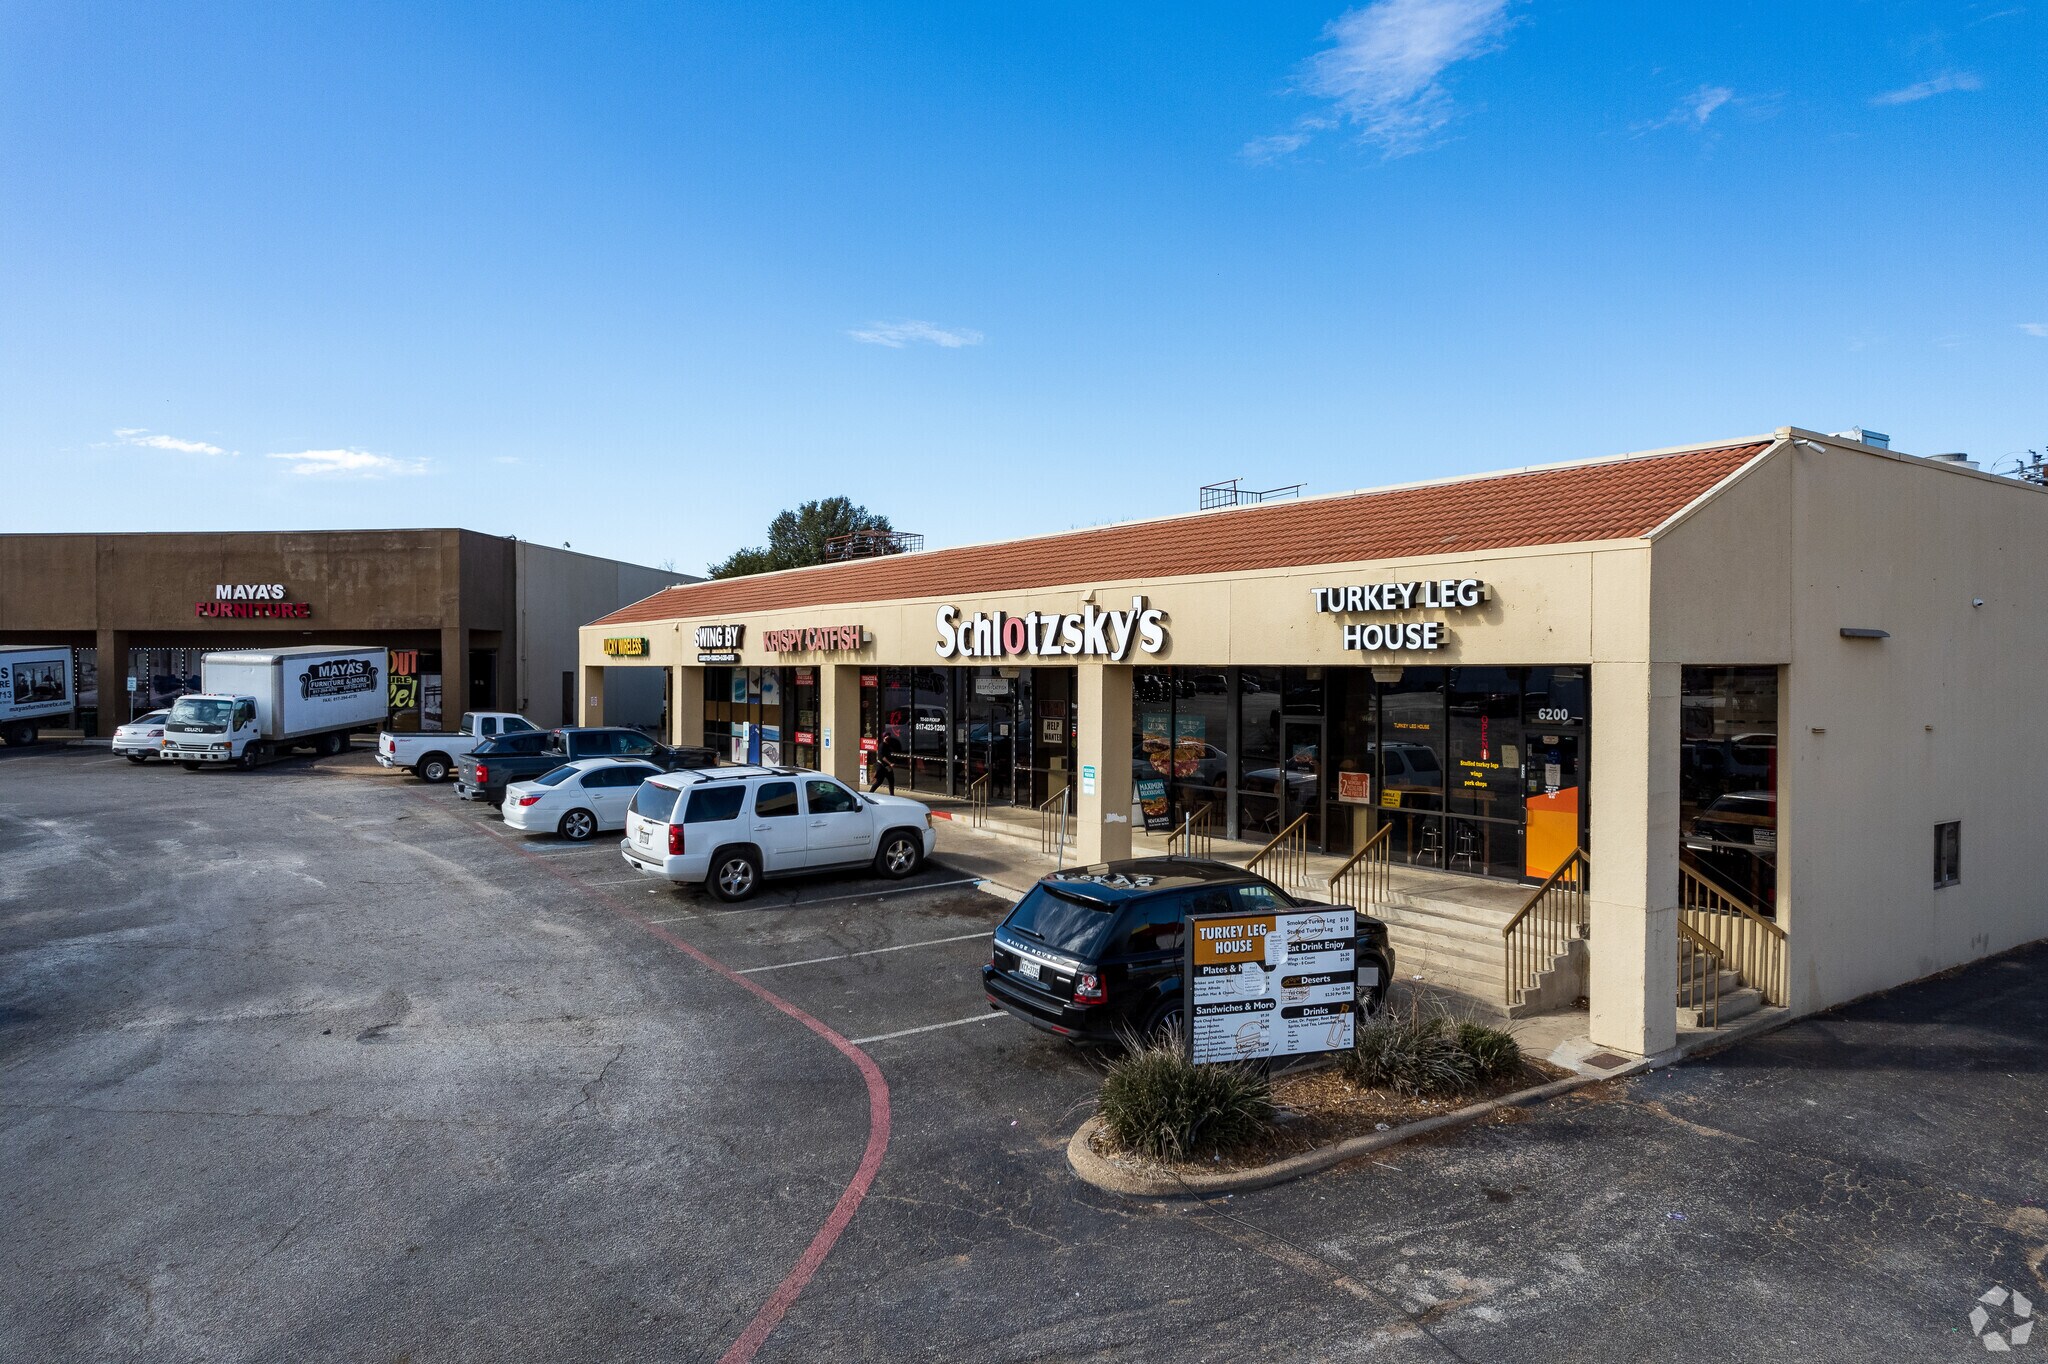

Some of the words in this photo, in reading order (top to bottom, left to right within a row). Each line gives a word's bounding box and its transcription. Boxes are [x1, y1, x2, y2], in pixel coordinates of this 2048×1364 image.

[215, 584, 284, 600] MAYA'S
[1310, 582, 1419, 613] TURKEY
[1425, 578, 1479, 608] LEG
[194, 602, 310, 618] FURNITURE
[935, 595, 1166, 662] Schlotzsky's
[694, 625, 723, 648] SWING
[725, 626, 739, 648] BY
[762, 628, 804, 653] KRISPY
[805, 624, 860, 651] CATFISH
[1342, 621, 1439, 651] HOUSE
[617, 637, 642, 655] WIRELESS
[318, 662, 363, 678] MAYA'S
[310, 677, 345, 688] FURNITURE
[345, 676, 351, 684] &
[351, 675, 367, 684] MORE
[1538, 708, 1568, 720] 6200
[915, 723, 945, 732] 817-423-1200
[1046, 721, 1059, 731] HELP
[1481, 715, 1489, 749] OPEN
[1044, 732, 1062, 742] WANTED
[1476, 761, 1491, 769] turkey
[1139, 781, 1164, 791] MAXIMUM
[1342, 779, 1348, 796] 2
[1199, 925, 1244, 940] TURKEY
[1247, 923, 1267, 937] LEG
[1006, 938, 1029, 951] RANGE
[1215, 939, 1253, 954] HOUSE
[1287, 944, 1300, 952] Eat
[1301, 942, 1323, 951] Drink
[1324, 941, 1345, 951] Enjoy
[1031, 948, 1058, 961] ROVER
[1203, 966, 1228, 975] Plates
[1229, 964, 1236, 973] &
[1301, 976, 1331, 985] Deserts
[1196, 1004, 1243, 1015] Sandwiches
[1244, 1002, 1252, 1011] &
[1253, 1001, 1275, 1010] More
[1303, 1006, 1329, 1016] Drinks
